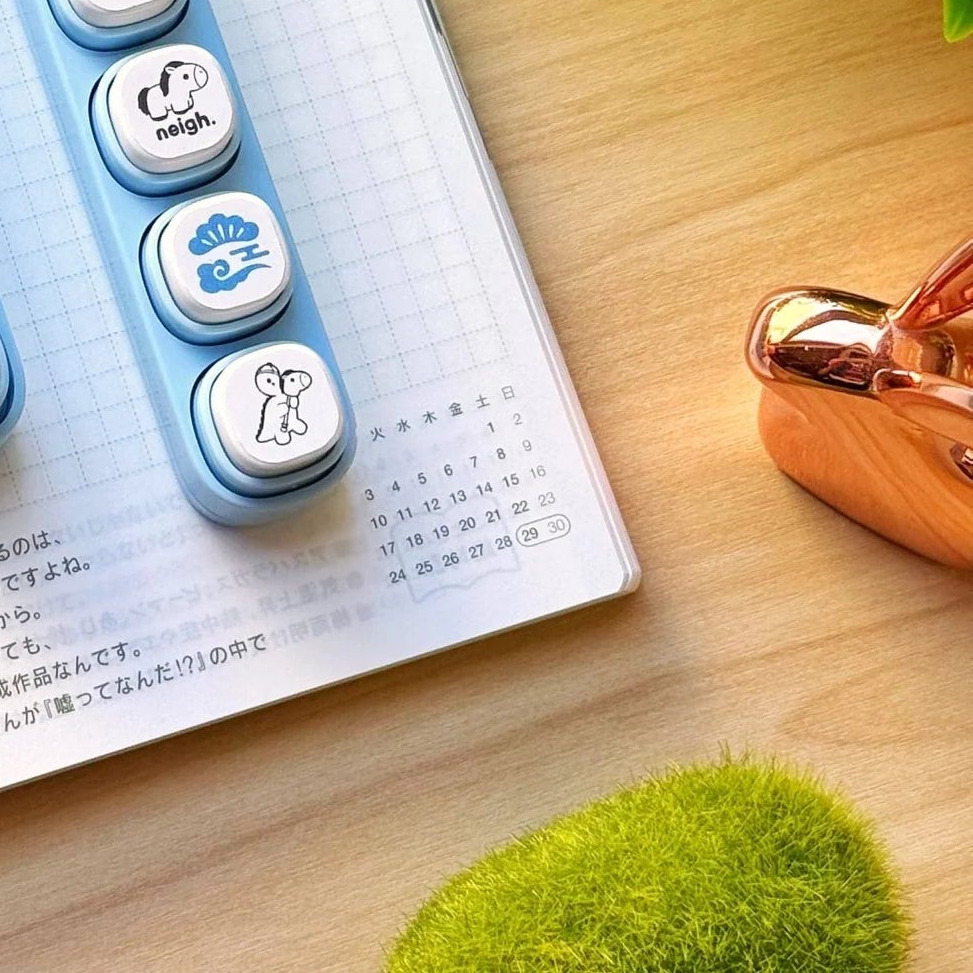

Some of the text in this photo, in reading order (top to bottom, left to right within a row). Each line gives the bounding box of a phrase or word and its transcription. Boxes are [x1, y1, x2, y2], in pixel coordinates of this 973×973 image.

[156, 111, 216, 141] neigh.
[370, 385, 515, 442] 火 水 木 金 土 日
[487, 413, 523, 433] 1 2
[365, 440, 532, 501] 3 4 5 6 7 8 9
[371, 465, 546, 528] 10 11 12 13 14 15 16
[380, 492, 556, 556] 17 18 19 20 21 22 23
[390, 519, 565, 583] 24 25 26 27 28 29 30
